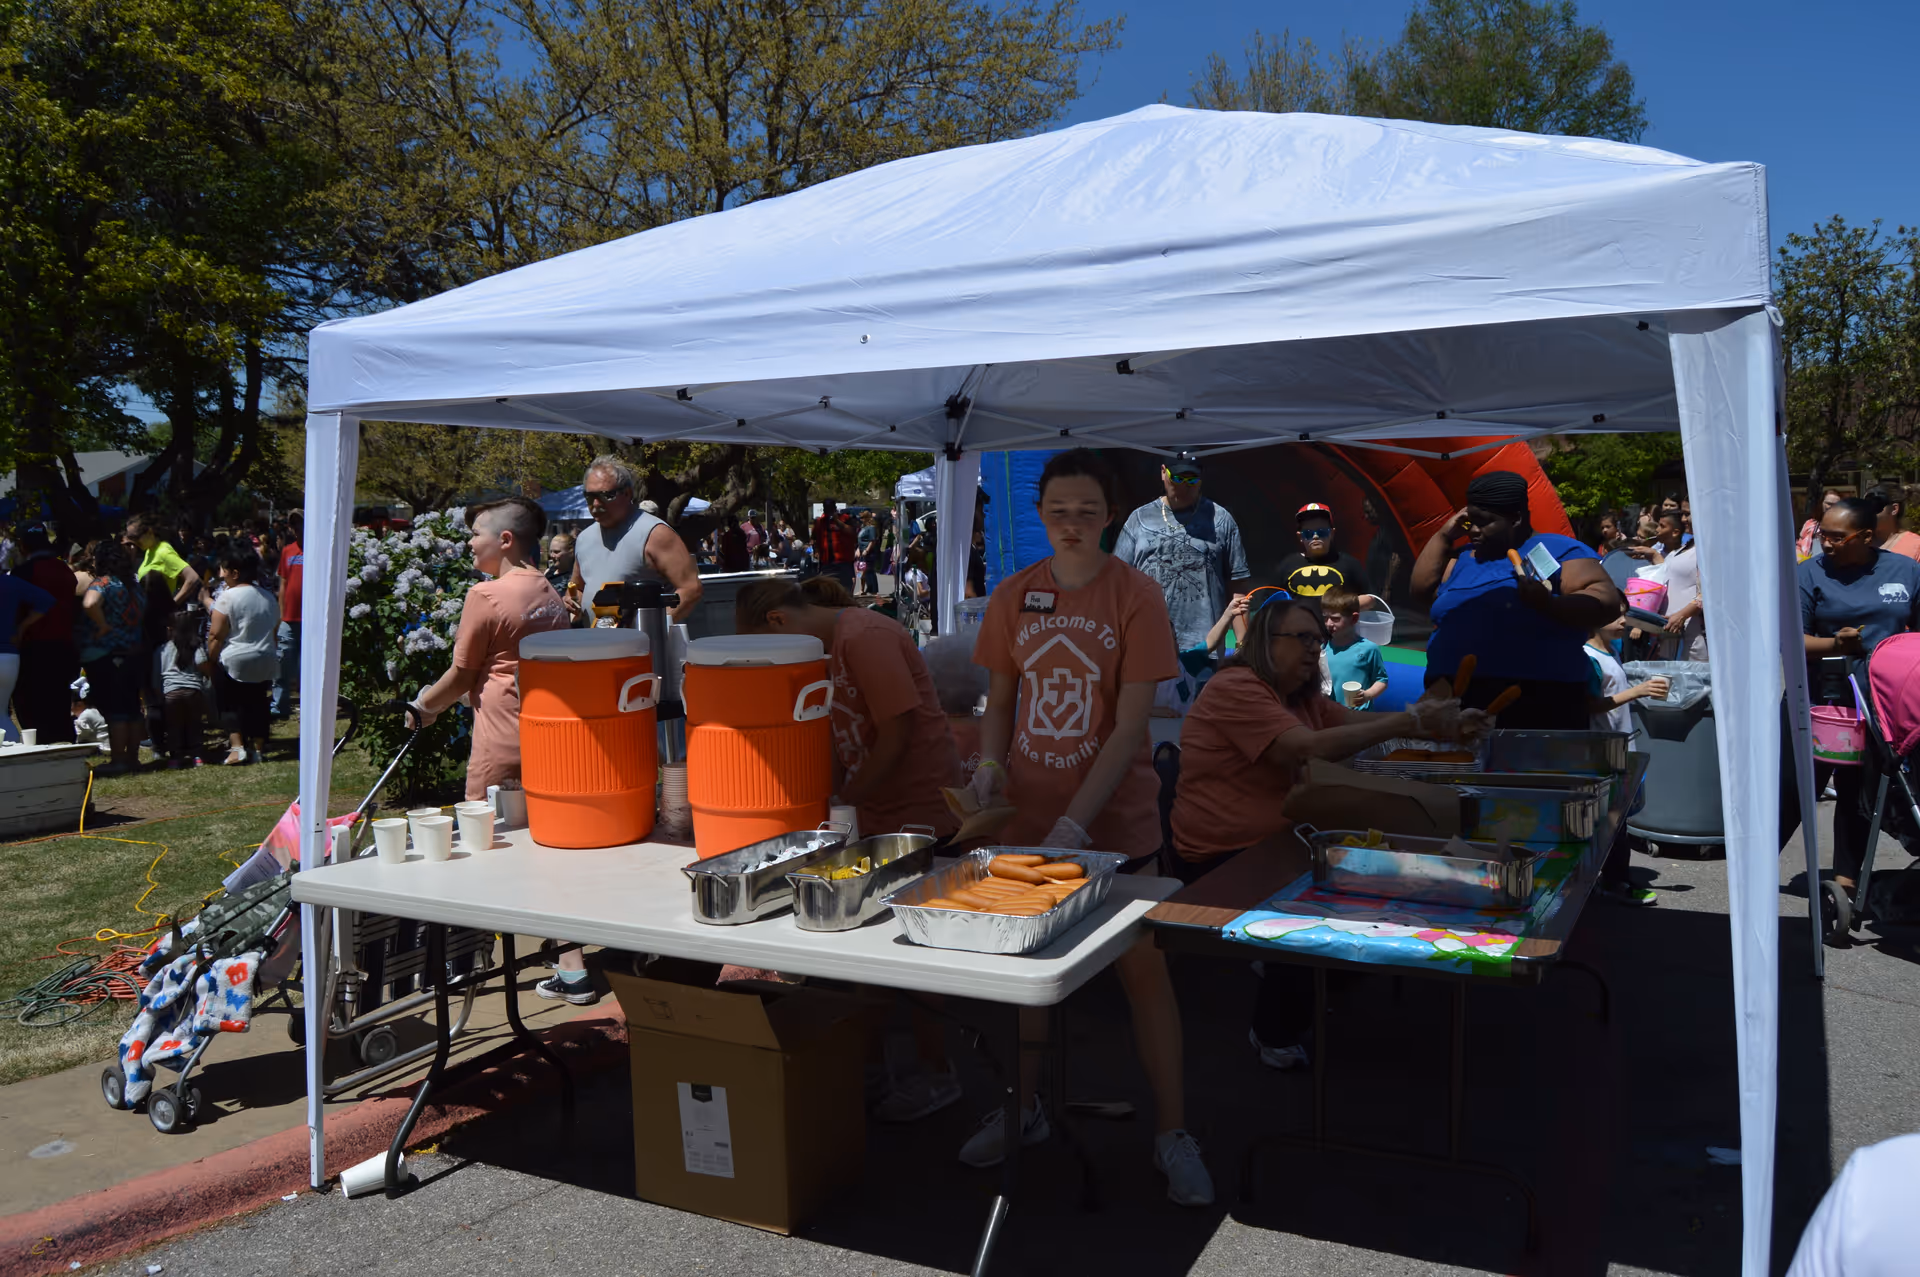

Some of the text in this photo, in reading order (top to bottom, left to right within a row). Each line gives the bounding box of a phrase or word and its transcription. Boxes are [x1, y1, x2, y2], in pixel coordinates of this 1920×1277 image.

[1016, 615, 1117, 650] Welcome To
[1016, 731, 1102, 770] The Family
